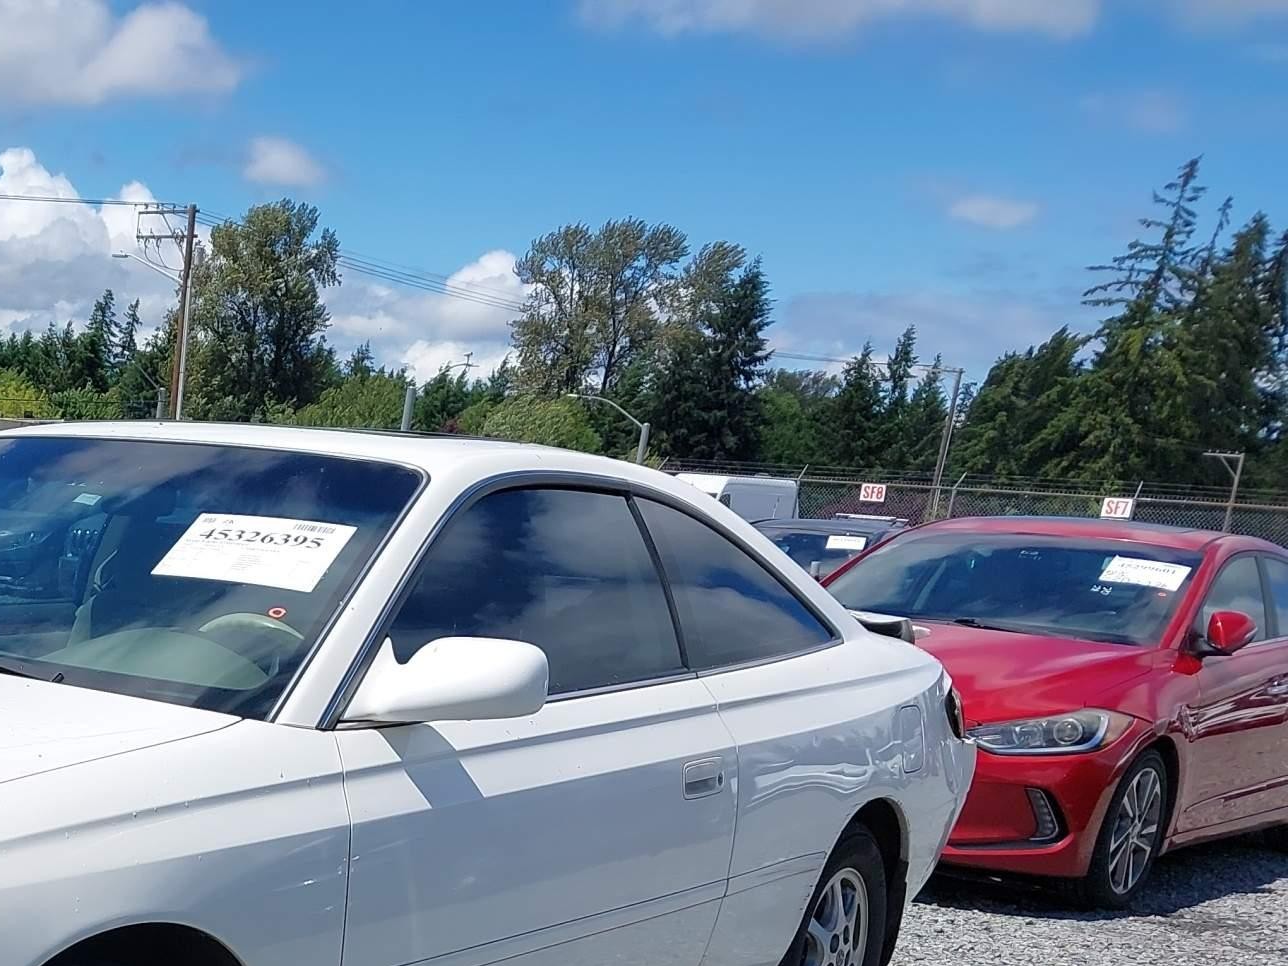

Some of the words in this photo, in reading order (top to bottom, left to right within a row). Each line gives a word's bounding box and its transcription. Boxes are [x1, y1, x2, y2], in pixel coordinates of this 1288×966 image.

[863, 486, 883, 499] SF8
[1105, 500, 1129, 515] SF7
[199, 527, 325, 549] 45326395
